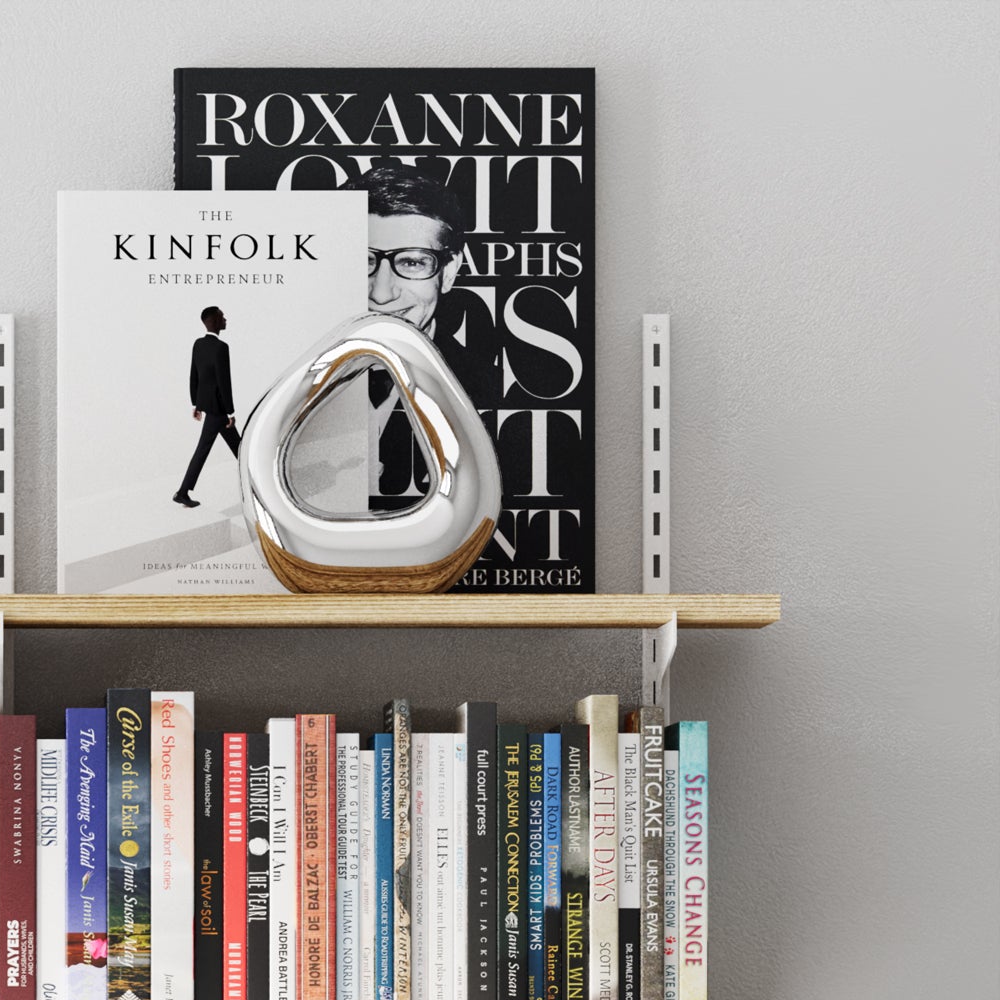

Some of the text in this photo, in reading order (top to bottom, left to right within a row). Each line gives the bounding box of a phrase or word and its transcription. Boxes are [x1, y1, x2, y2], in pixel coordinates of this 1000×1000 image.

[196, 92, 582, 148] ROXANNE
[114, 233, 319, 261] KINFOLK
[199, 210, 233, 221] THE
[148, 274, 285, 285] ENTREPRENEUR
[176, 562, 186, 570] for
[494, 566, 581, 586] BERGÉ
[398, 705, 408, 750] ORANGES
[398, 752, 408, 770] ARE
[529, 743, 543, 761] P6)
[40, 749, 58, 847] MIDLIFE CRISIS
[77, 728, 96, 869] The Avenging Maid
[116, 707, 142, 837] Curse of the Exile
[161, 699, 175, 891] Red Shoes and other short stories
[202, 748, 213, 817] Ashley Mussbacher
[229, 736, 242, 843] NORWEGIAN WOOD
[249, 765, 270, 823] STEINBECK
[305, 742, 319, 849] OBERST CHABERT
[398, 772, 408, 790] NOT
[398, 793, 408, 810] THE
[475, 749, 489, 836] full court press
[529, 775, 543, 793] (P5
[531, 764, 542, 772] &
[568, 746, 581, 853] AUTHOR LASTNAME
[644, 725, 662, 838] FRUITCAKE
[13, 746, 22, 864] SWABRINA NONYA
[338, 746, 347, 880] THE PROFESSIONAL TOUR GUIDE TEST
[349, 746, 358, 880] STUDY GUIDE FOR
[398, 811, 408, 836] ONLY
[504, 742, 520, 912] THE JERUSALEM CONNECTION
[530, 799, 542, 866] PROBLEMS
[594, 769, 615, 903] AFTER DAYS
[620, 744, 637, 884] The Black Man's Quit List
[399, 838, 408, 862] FRUIT
[665, 769, 676, 928] DACHSHUND THROUGH THE SNOW
[684, 773, 706, 967] SEASONS CHANGE
[117, 859, 137, 968] Janis Susan May
[200, 859, 219, 936] the law of soil
[305, 864, 320, 987] HONORÉ DE BALZAC
[530, 908, 542, 951] SMART
[568, 892, 583, 959] STRANGE
[646, 859, 658, 952] URSULA EVANS
[7, 919, 20, 987] PRAYERS
[278, 921, 288, 963] ANDREA
[505, 928, 519, 958] Janis
[599, 942, 611, 976] SCOTT
[508, 962, 520, 997] Susan
[665, 965, 676, 988] KATE
